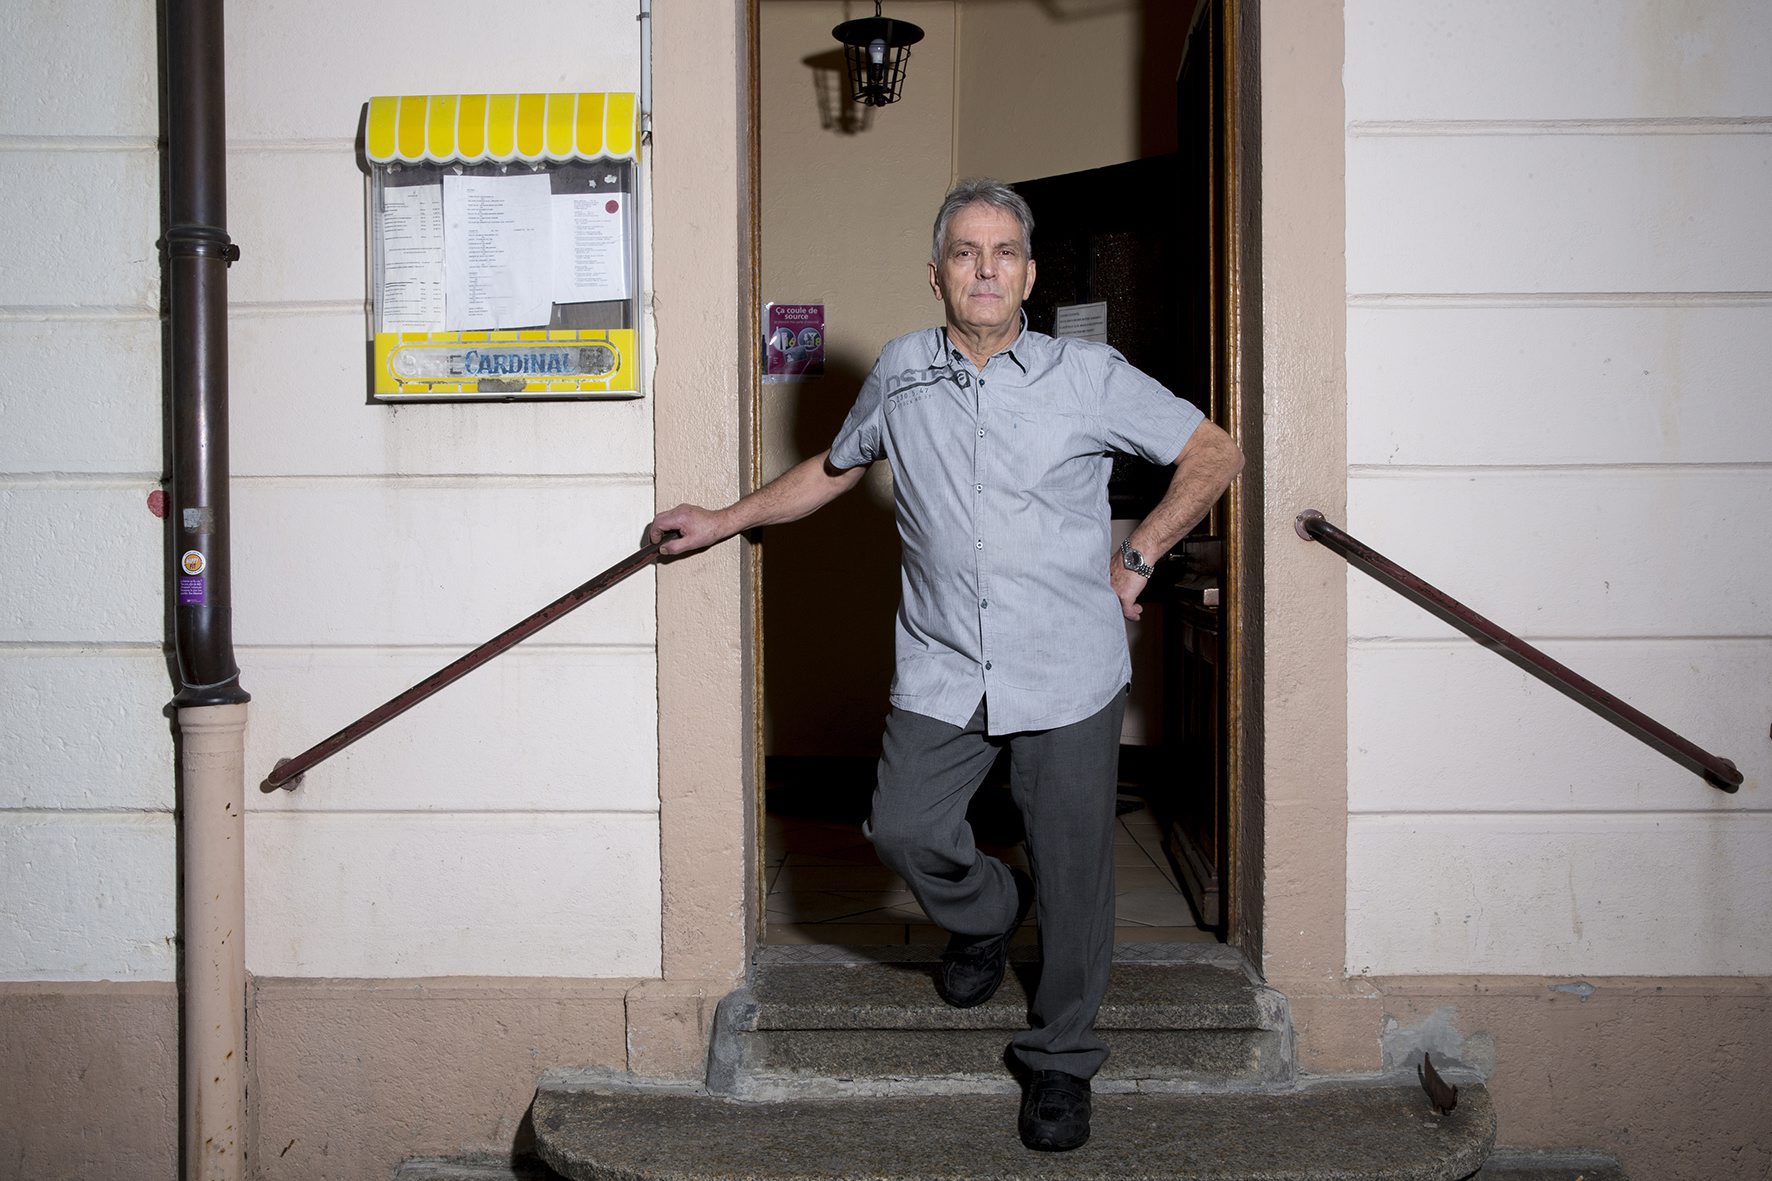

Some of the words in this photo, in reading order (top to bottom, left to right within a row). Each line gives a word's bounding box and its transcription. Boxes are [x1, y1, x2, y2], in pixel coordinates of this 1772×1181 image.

[775, 306, 786, 315] Ça
[786, 306, 807, 314] coule
[808, 306, 818, 314] de
